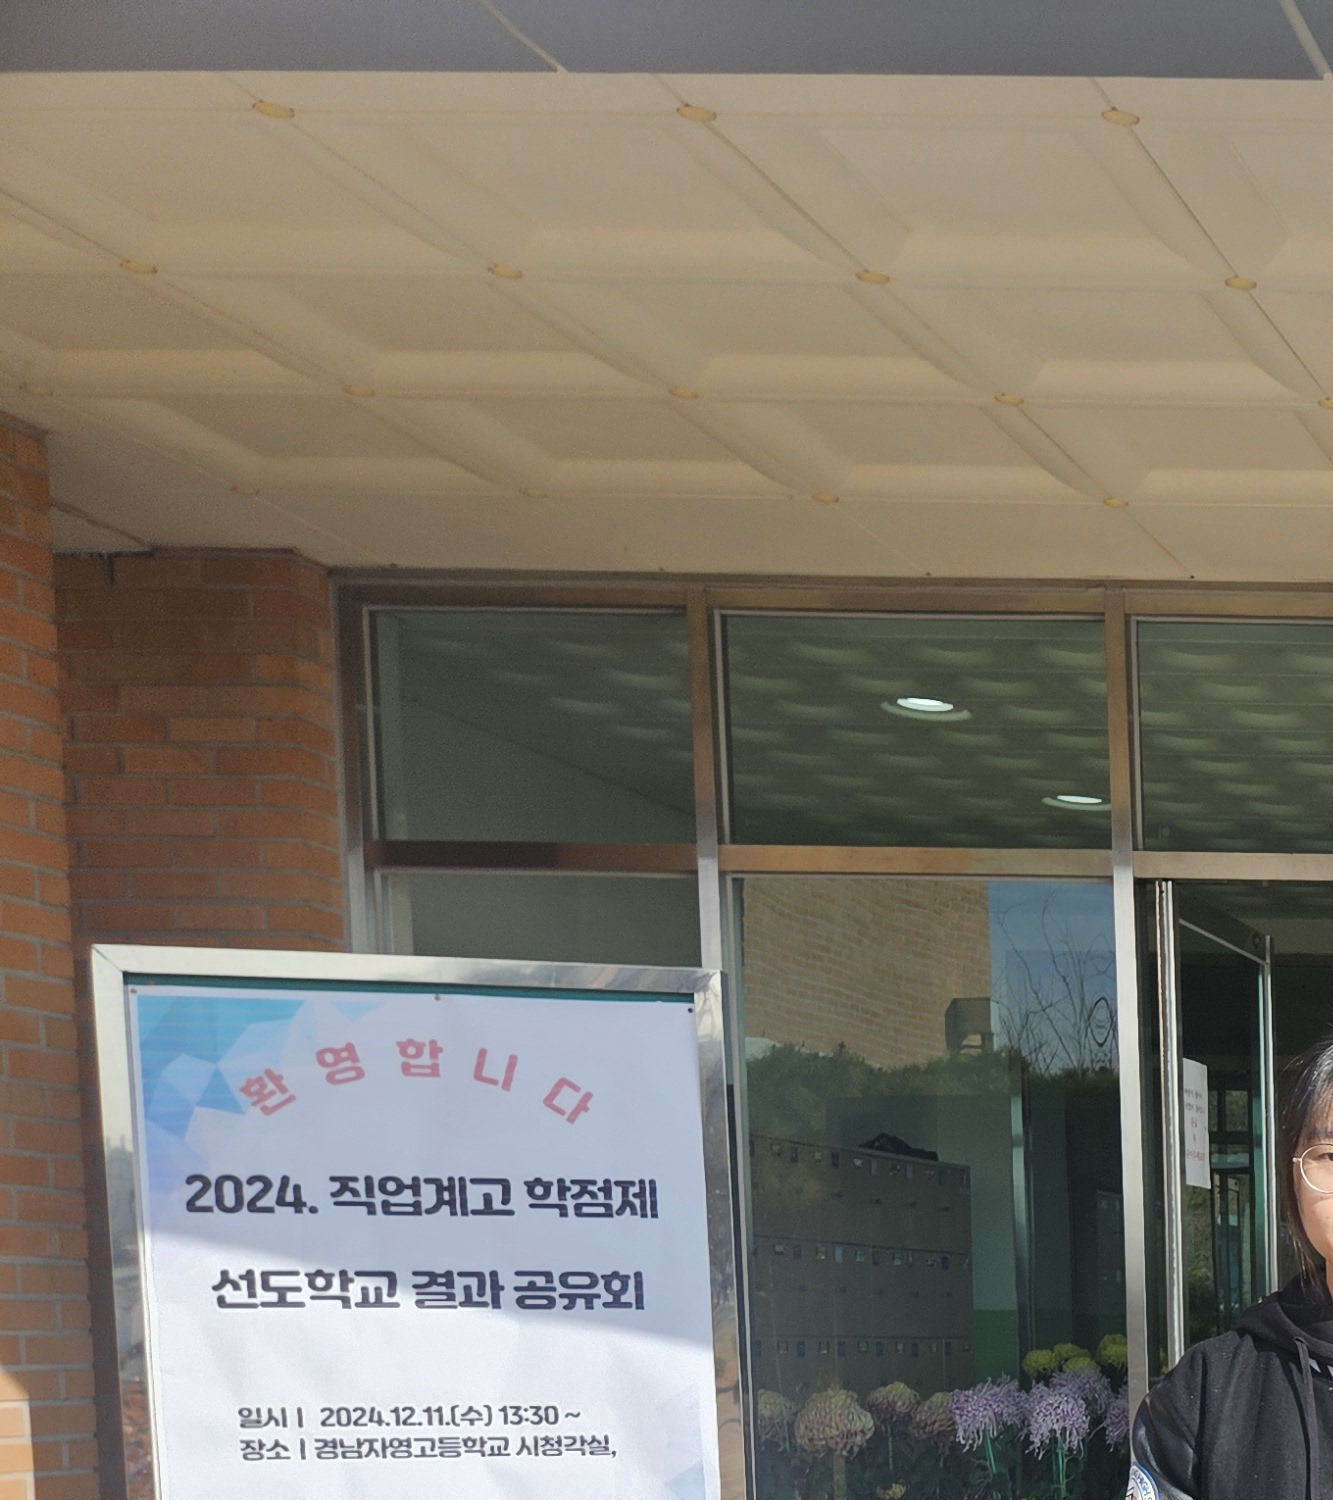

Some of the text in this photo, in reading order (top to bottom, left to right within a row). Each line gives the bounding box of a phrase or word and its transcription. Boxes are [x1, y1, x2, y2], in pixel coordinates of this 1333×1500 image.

[239, 1038, 594, 1125] 환영합니다
[185, 1173, 659, 1219] 2024. 직업계고 학점제
[211, 1269, 645, 1311] 선도학교 결과 공유회
[238, 1407, 288, 1428] 일시
[240, 1439, 289, 1461] 장소
[315, 1437, 511, 1460] 경남자영고등학교
